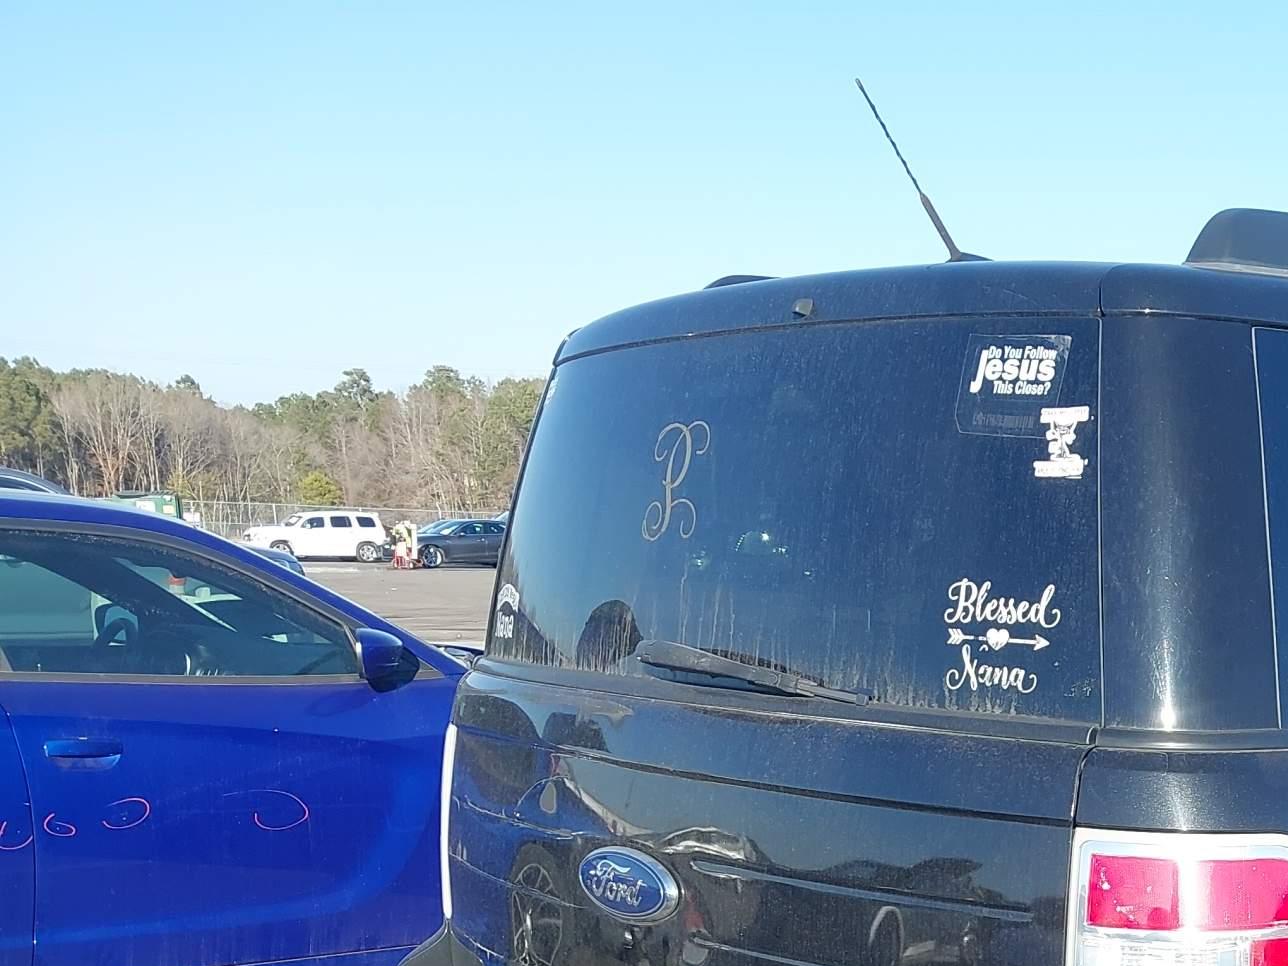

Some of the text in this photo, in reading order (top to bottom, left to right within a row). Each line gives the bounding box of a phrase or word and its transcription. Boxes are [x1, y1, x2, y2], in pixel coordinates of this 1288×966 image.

[969, 349, 1056, 394] Jesus
[988, 345, 1058, 361] Do You Follow
[993, 381, 1052, 396] This Close?
[944, 577, 1061, 628] Blessed
[946, 644, 1038, 693] Nana
[588, 858, 648, 908] Ford
